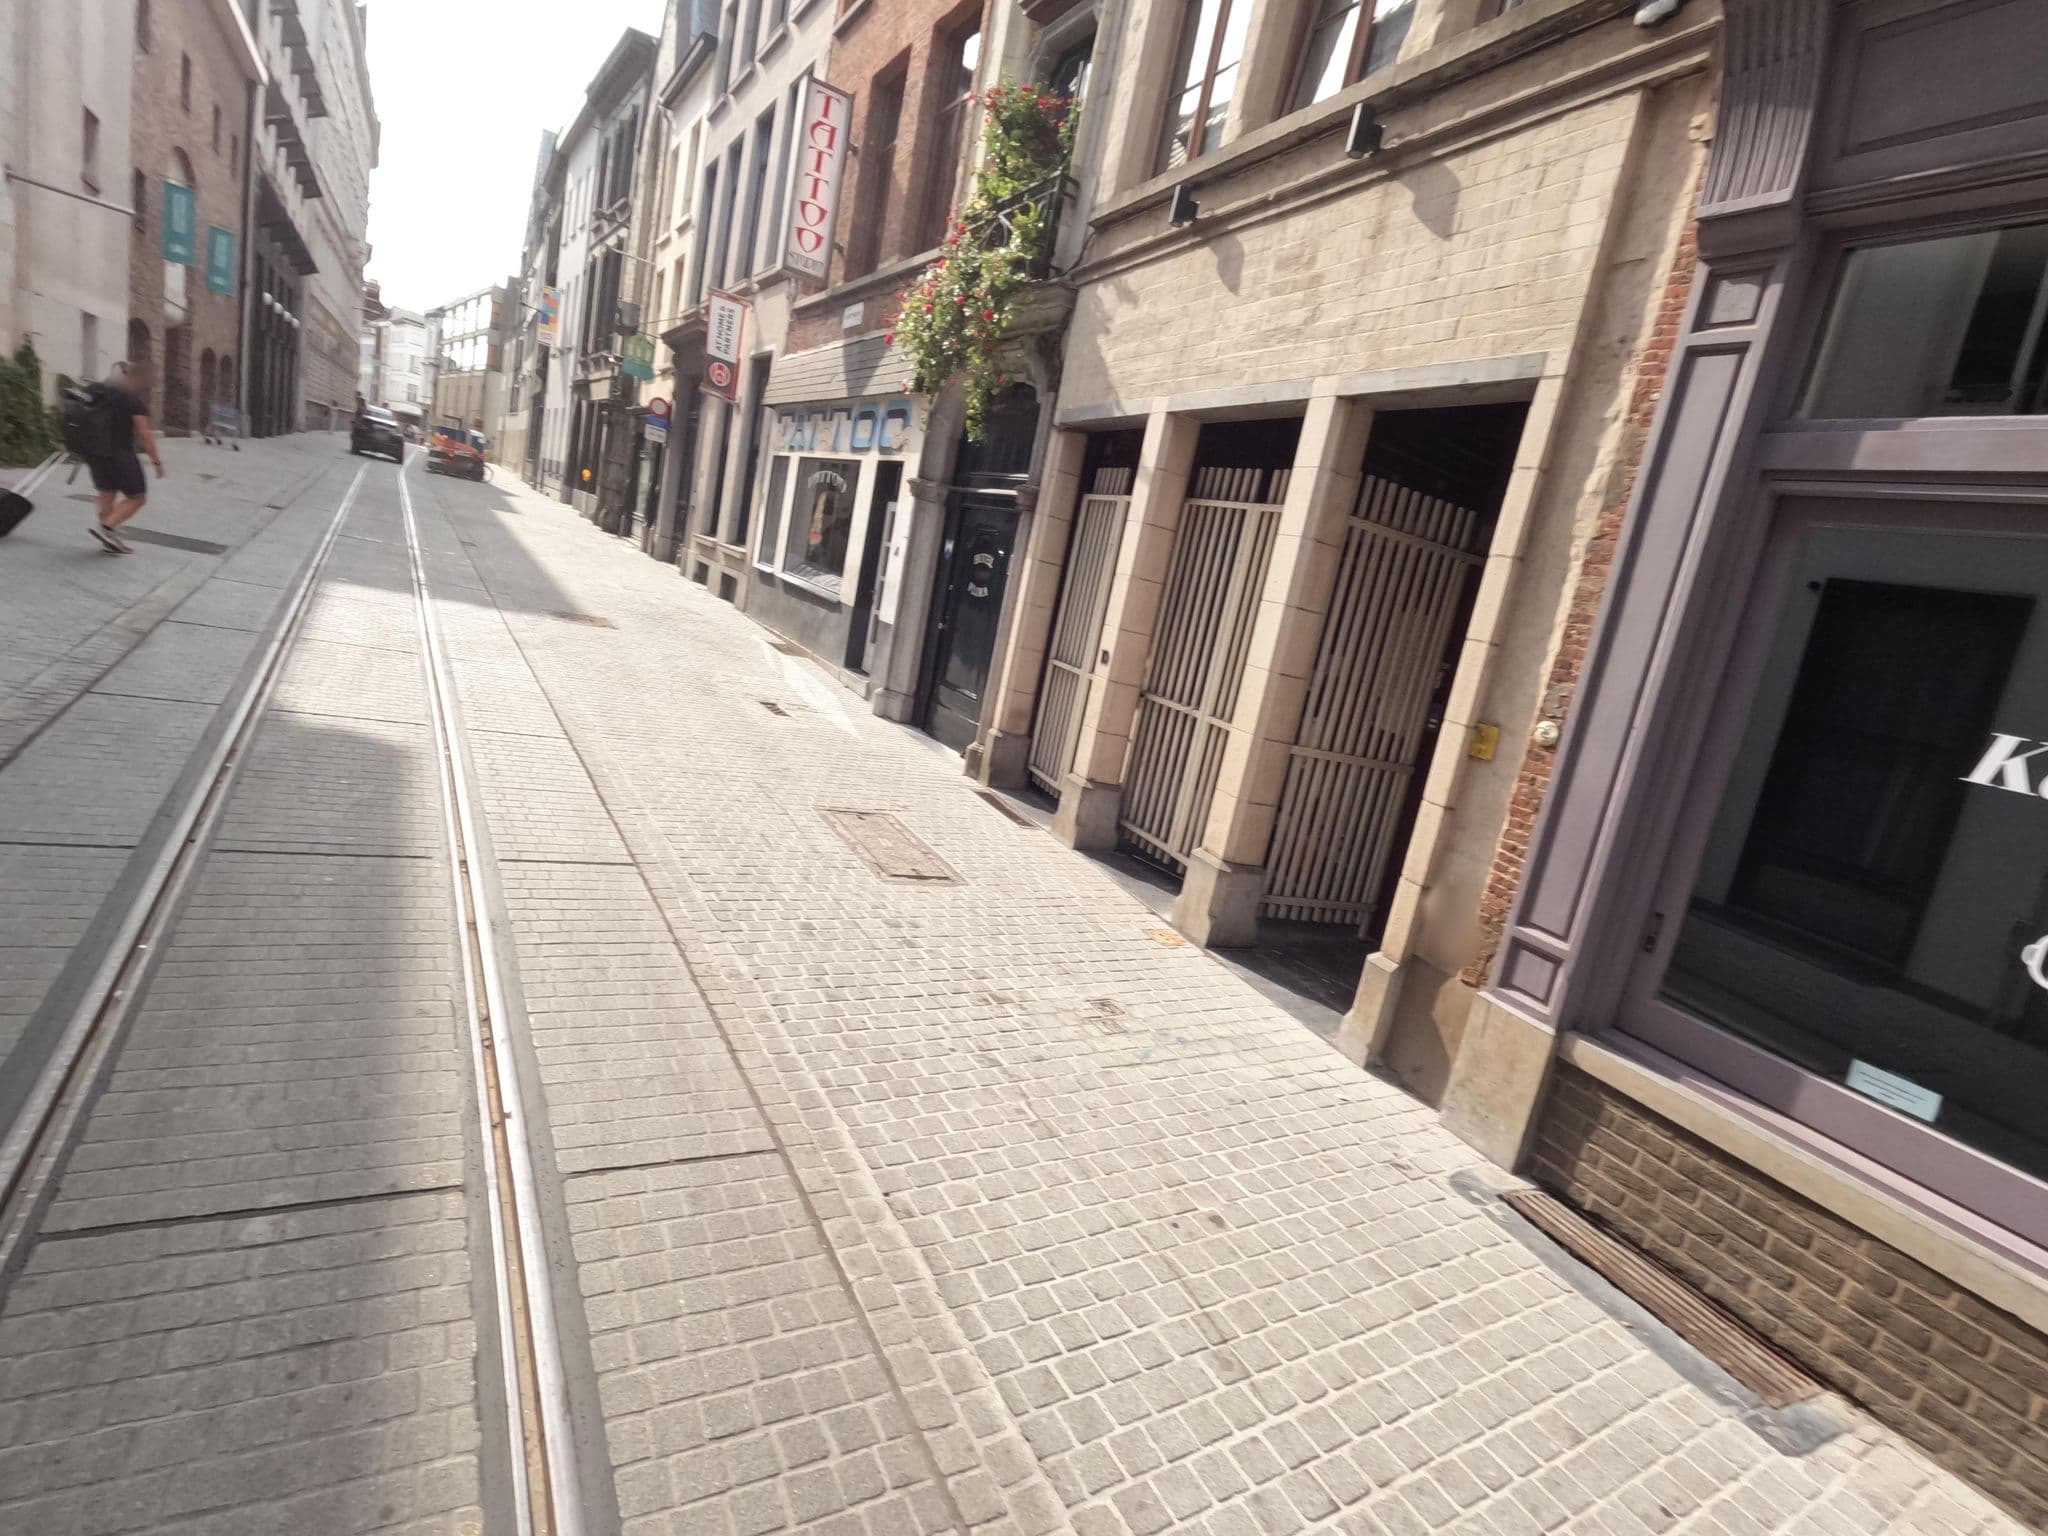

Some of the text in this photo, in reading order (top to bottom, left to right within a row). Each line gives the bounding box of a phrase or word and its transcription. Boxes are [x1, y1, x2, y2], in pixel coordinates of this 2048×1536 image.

[795, 90, 841, 253] TATTOO
[723, 308, 736, 356] PARTNERS
[1958, 732, 2048, 800] K
